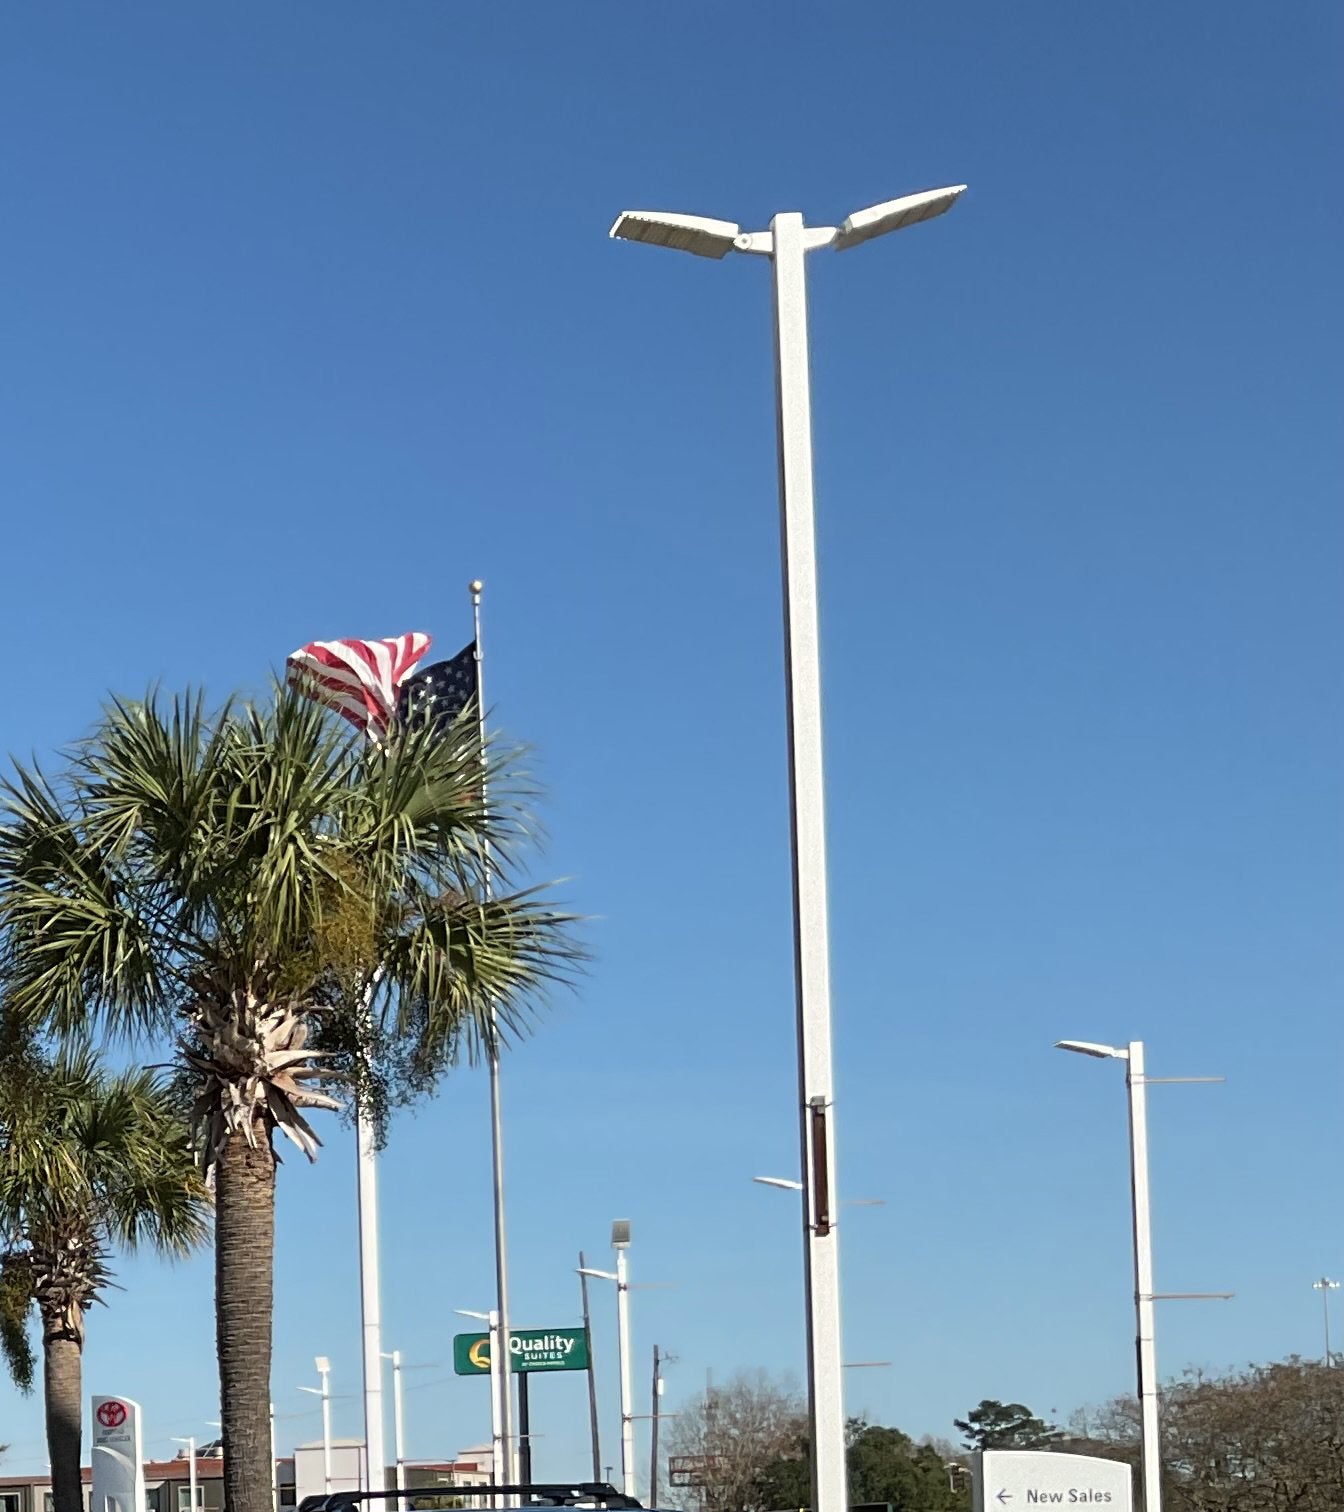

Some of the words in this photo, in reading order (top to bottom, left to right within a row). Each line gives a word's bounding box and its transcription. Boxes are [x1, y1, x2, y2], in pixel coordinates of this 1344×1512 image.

[509, 1335, 574, 1354] Quality
[524, 1351, 563, 1360] SUITES
[1027, 1489, 1063, 1503] New
[1068, 1488, 1112, 1503] Sales
